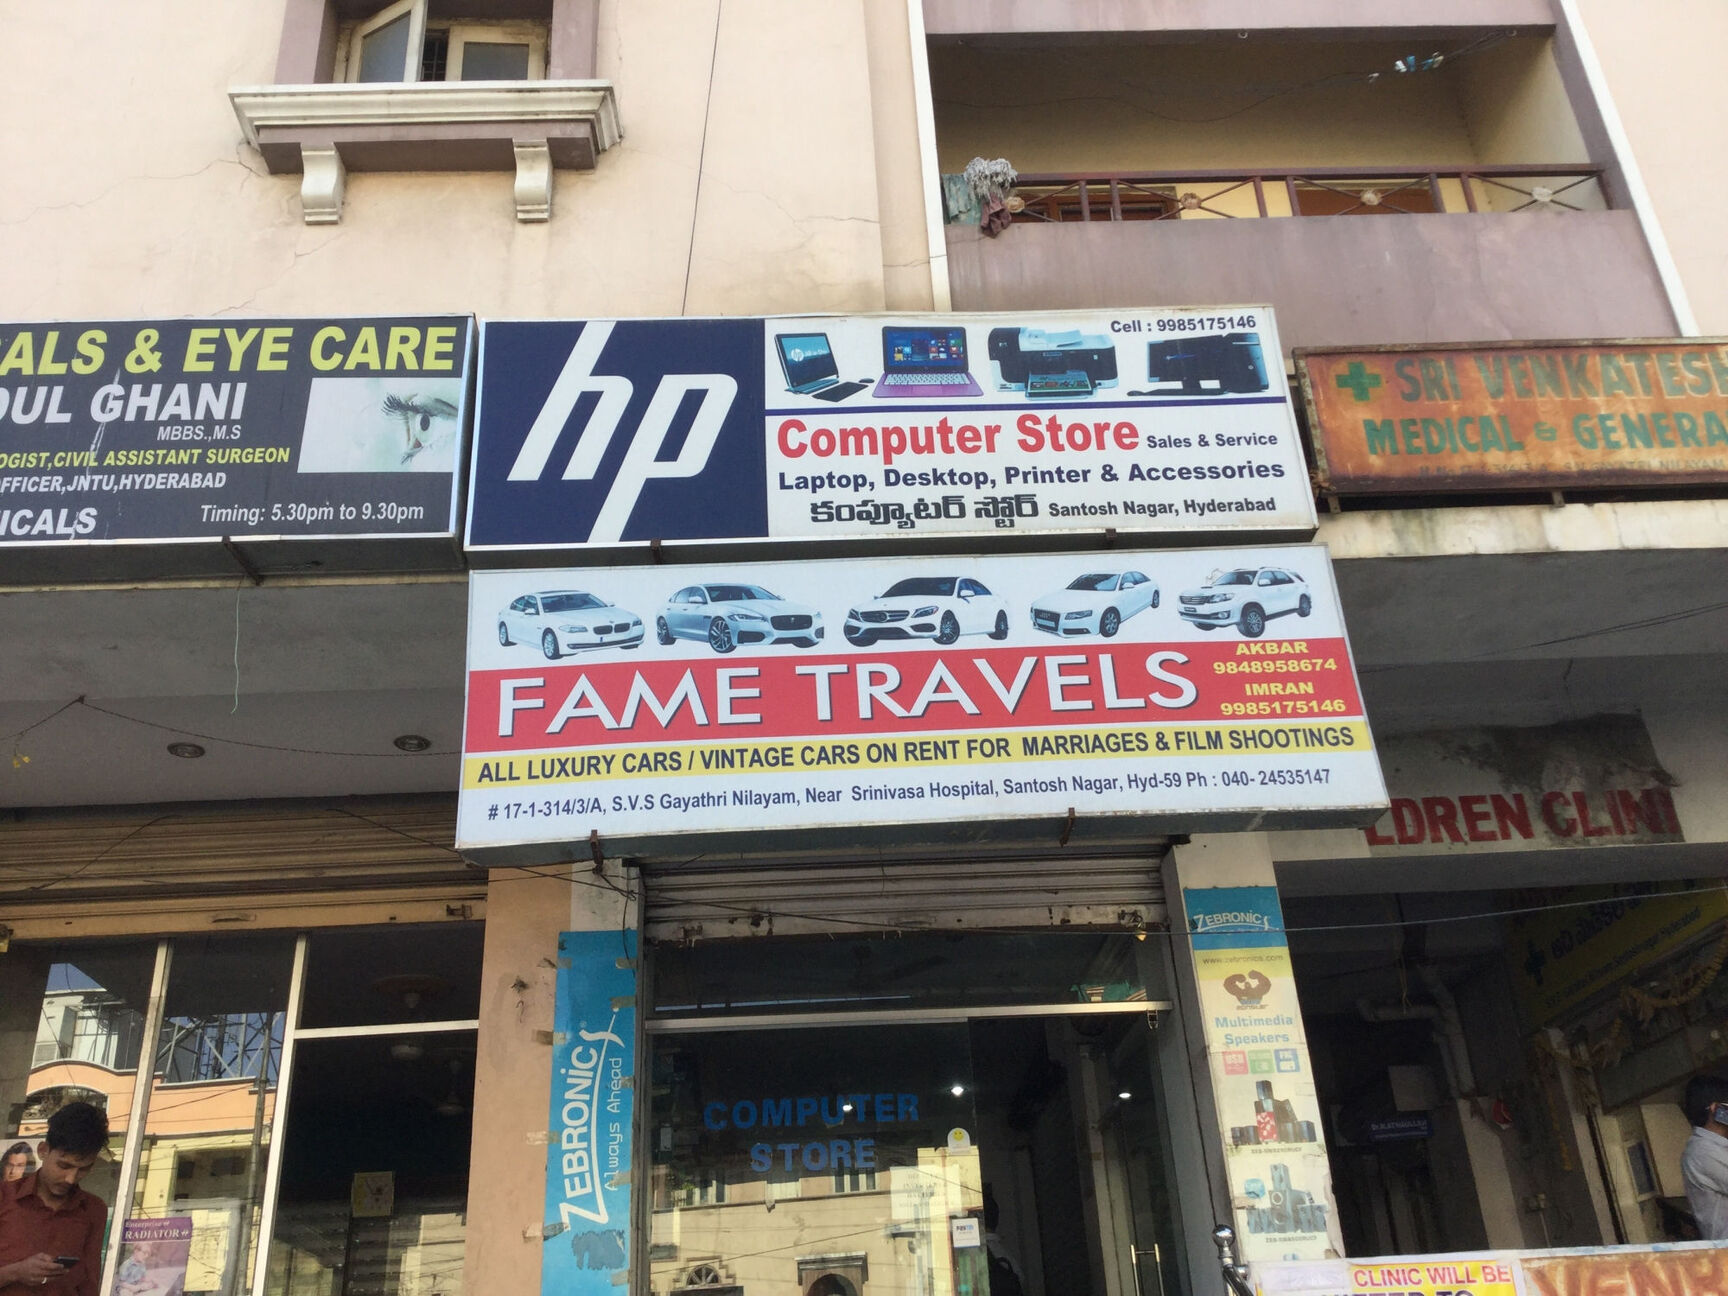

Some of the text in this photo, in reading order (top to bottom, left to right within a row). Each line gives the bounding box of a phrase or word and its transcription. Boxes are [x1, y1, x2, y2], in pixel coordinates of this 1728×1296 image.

[1110, 318, 1142, 333] Cell
[1156, 314, 1257, 332] 9985175146
[0, 326, 457, 376] ALS & EYE CARE
[1395, 355, 1465, 403] SRI
[90, 382, 247, 422] GHANI
[506, 321, 738, 543] hp
[777, 413, 1140, 465] Computer Store
[1147, 431, 1278, 449] Sales & Service
[1363, 413, 1525, 456] MEDICAL
[104, 448, 202, 467] ASSISTANT
[206, 447, 290, 465] SURGEON
[0, 472, 226, 494] FFICER,JNTU,HYDERABAD
[778, 461, 1285, 492] Laptop, Desktop, Printer & Accessories
[200, 502, 424, 525] Timing: 5.30pm to 9.30pm
[1048, 497, 1276, 518] Santosh Nagar, Hyderabad
[1236, 641, 1308, 655] AKBAR
[1213, 658, 1337, 674] 9848958674
[498, 651, 1198, 737] FAME TRAVELS
[1245, 681, 1314, 696] IMRAN
[1220, 700, 1346, 716] 9985175146
[477, 762, 520, 783] ALL
[528, 754, 614, 779] LUXURY
[622, 751, 682, 773] CARS
[700, 746, 794, 770] VINTAGE
[800, 743, 860, 766] CARS
[866, 741, 897, 762] ON
[904, 739, 960, 762] RENT
[967, 738, 1009, 759] FOR
[1022, 732, 1148, 757] MARRIAGES
[1155, 731, 1170, 751] &
[1176, 729, 1224, 751] FILM
[1229, 727, 1354, 750] SHOOTINGS
[612, 794, 655, 812] S.V.S
[660, 790, 728, 813] Gayathri
[732, 787, 801, 809] Nilayam,
[805, 787, 842, 803] Near
[851, 782, 925, 801] Srinivasa
[929, 778, 999, 801] Hospital,
[1003, 776, 1069, 795] Santosh
[1073, 774, 1123, 795] Nagar,
[1127, 771, 1182, 791] Hyd-59
[1186, 771, 1208, 787] Ph
[1258, 768, 1331, 786] 24535147
[1215, 1015, 1293, 1028] Multimedia
[1225, 1032, 1290, 1047] Speakers
[604, 1057, 623, 1191] Always Ahead
[703, 1093, 920, 1131] COMPUTER
[749, 1138, 876, 1173] STORE
[1353, 1265, 1512, 1288] CLINIC WILL BE
